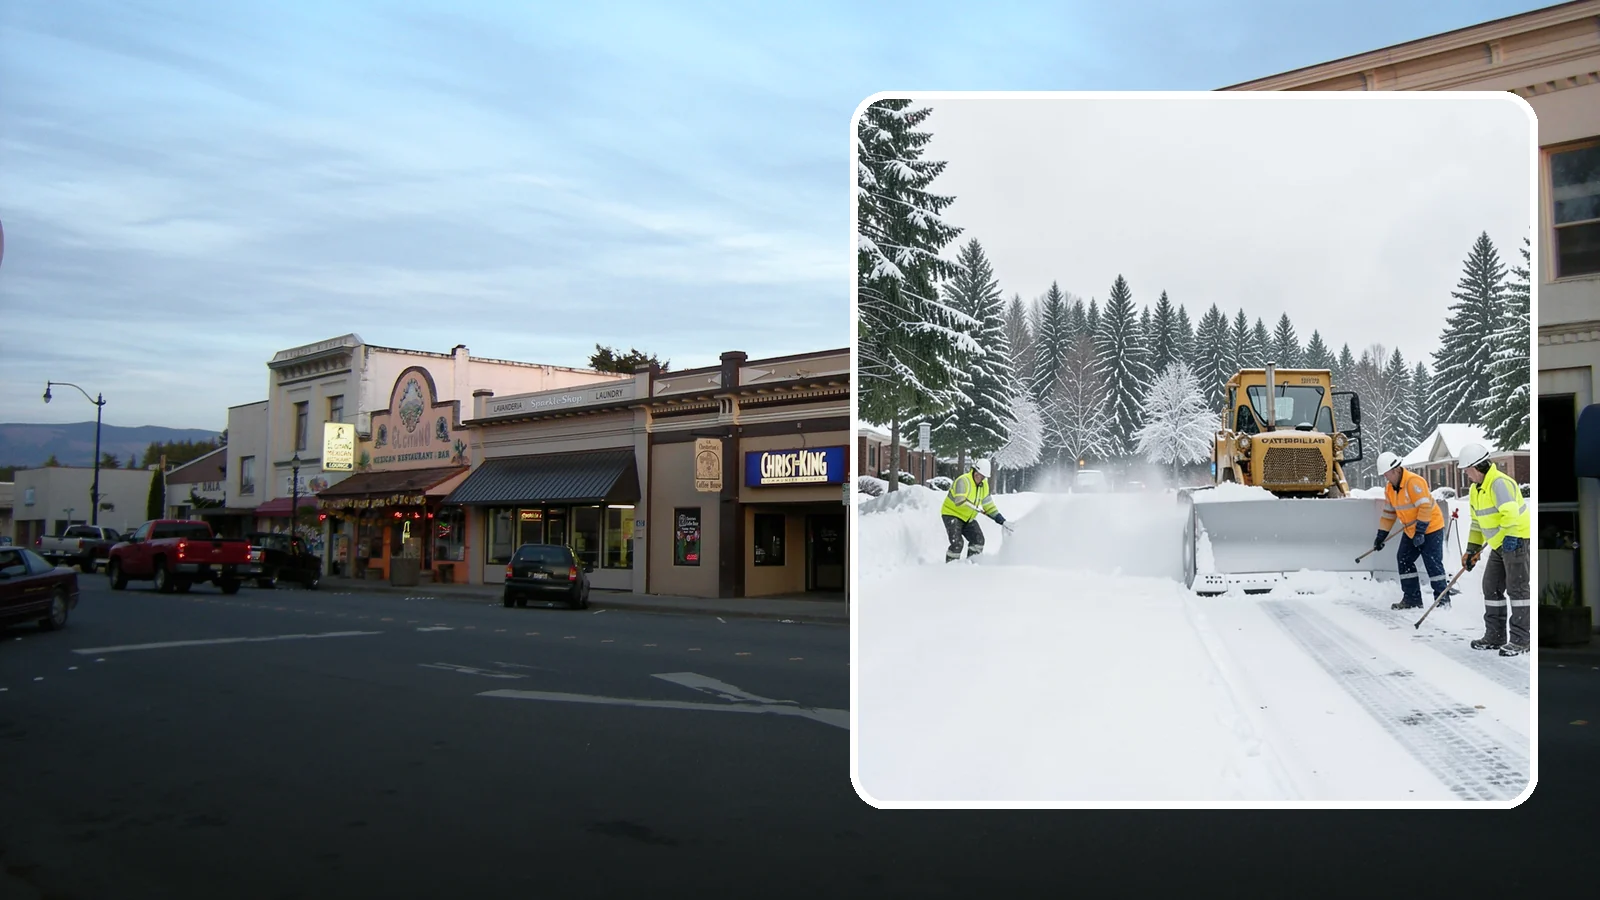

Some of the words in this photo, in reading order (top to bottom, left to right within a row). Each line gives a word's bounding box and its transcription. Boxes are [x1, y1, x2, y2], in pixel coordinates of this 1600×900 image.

[595, 389, 624, 399] LAUNDRY
[493, 402, 523, 412] LAVANDERIA
[374, 456, 396, 464] MEXICAN
[398, 452, 433, 462] RESTAURANT
[438, 450, 450, 459] BAR
[761, 453, 797, 478] CHRIST
[799, 450, 827, 476] KING
